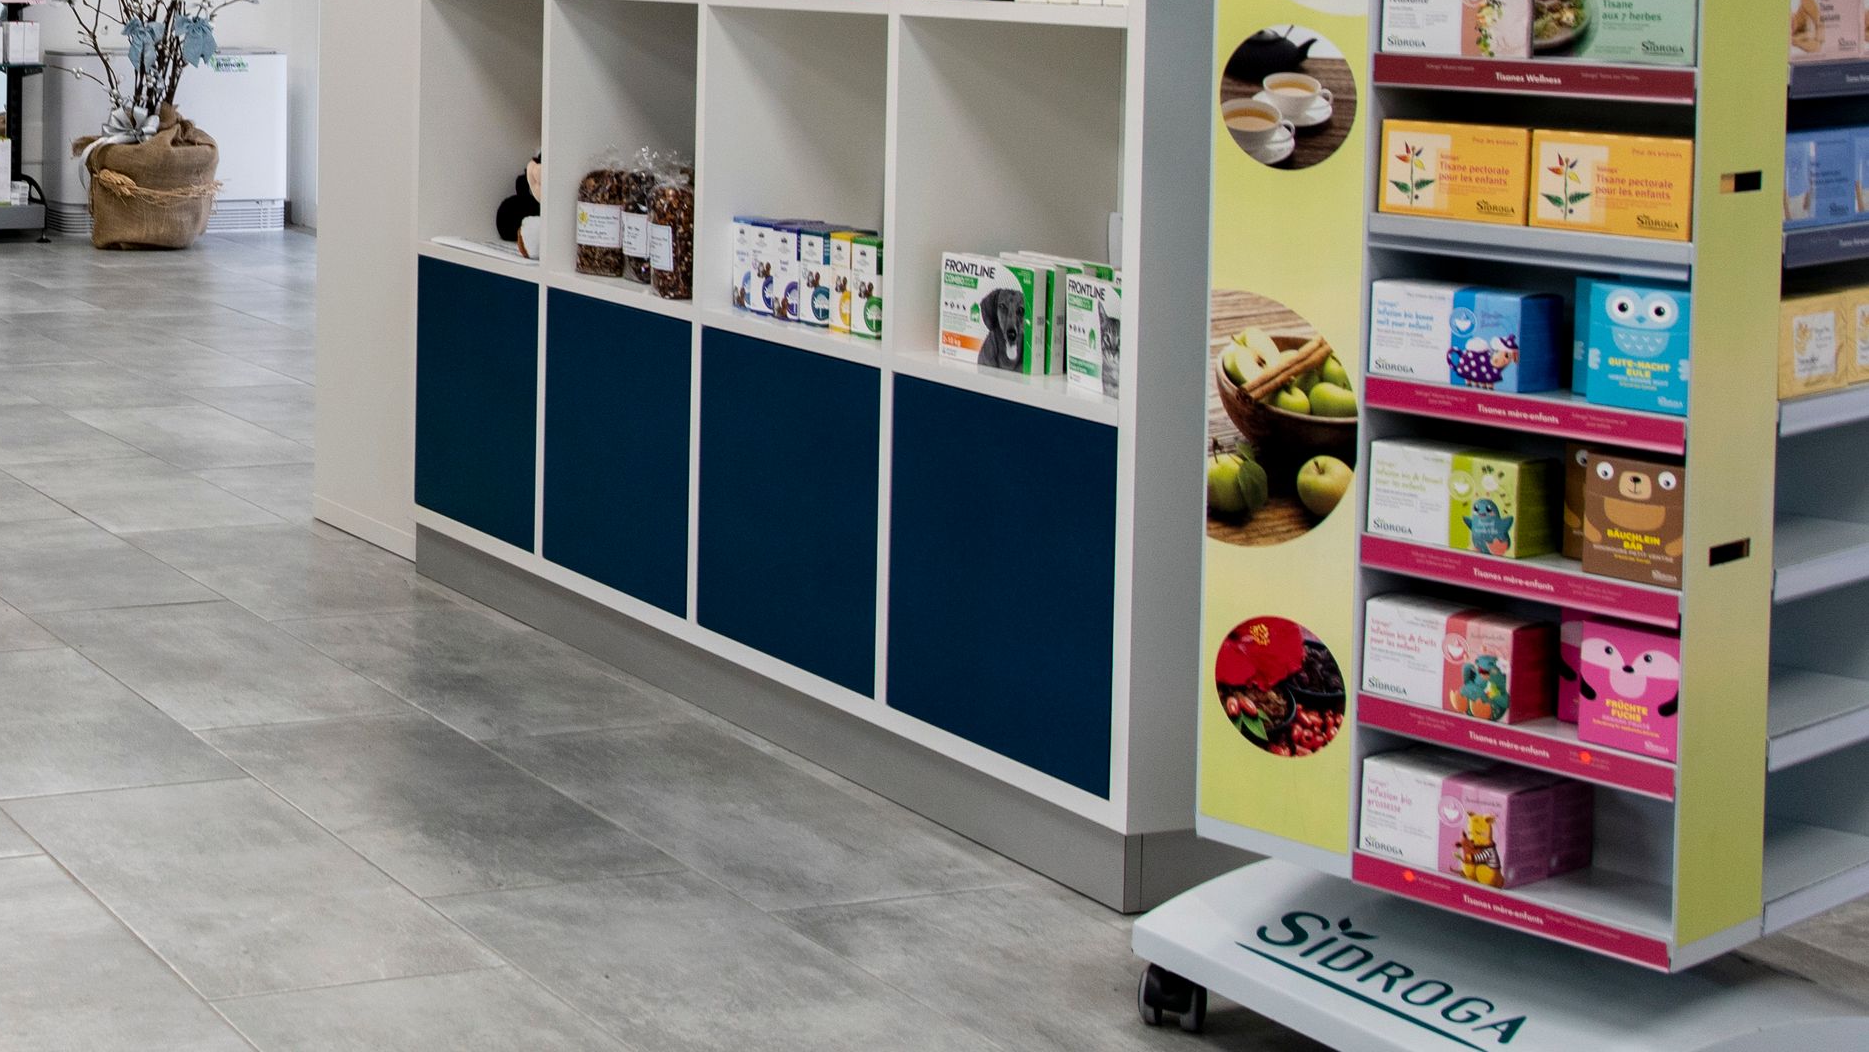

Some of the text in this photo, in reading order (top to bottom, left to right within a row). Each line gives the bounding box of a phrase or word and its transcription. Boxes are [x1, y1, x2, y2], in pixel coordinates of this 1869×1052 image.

[1603, 0, 1633, 9] Tisane
[1602, 13, 1618, 22] aux
[1629, 11, 1662, 22] herbes
[1387, 36, 1426, 48] SIDROGA
[1642, 40, 1684, 54] SIDROGA
[1495, 72, 1562, 85] Tisanes Wellness
[1440, 161, 1509, 175] Tisane pectorale
[1439, 172, 1507, 185] pour les enfants
[1595, 175, 1673, 189] Tisane pectorale
[1595, 186, 1671, 200] pour les enfants
[1476, 201, 1515, 214] SIDROGA
[1637, 215, 1679, 229] SIDROGA
[945, 259, 996, 279] FRONTLINE
[1068, 279, 1106, 301] FRONTLINE
[1375, 360, 1415, 374] SIDROGA
[1477, 404, 1559, 425] Tisanes mère-enfants
[1373, 519, 1412, 535] SIDROGA
[1607, 528, 1661, 546] BÄUCHLEIN
[1623, 540, 1643, 551] BÄR
[1473, 568, 1554, 592] Tisanes mère-enfants
[1368, 677, 1407, 696] SIDROGA
[1469, 731, 1550, 758] Tisanes mère-enfants
[1365, 837, 1403, 856] SIDROGA
[1463, 894, 1544, 926] Tisanes mère-enfants
[1256, 910, 1528, 1045] SIDROGA
